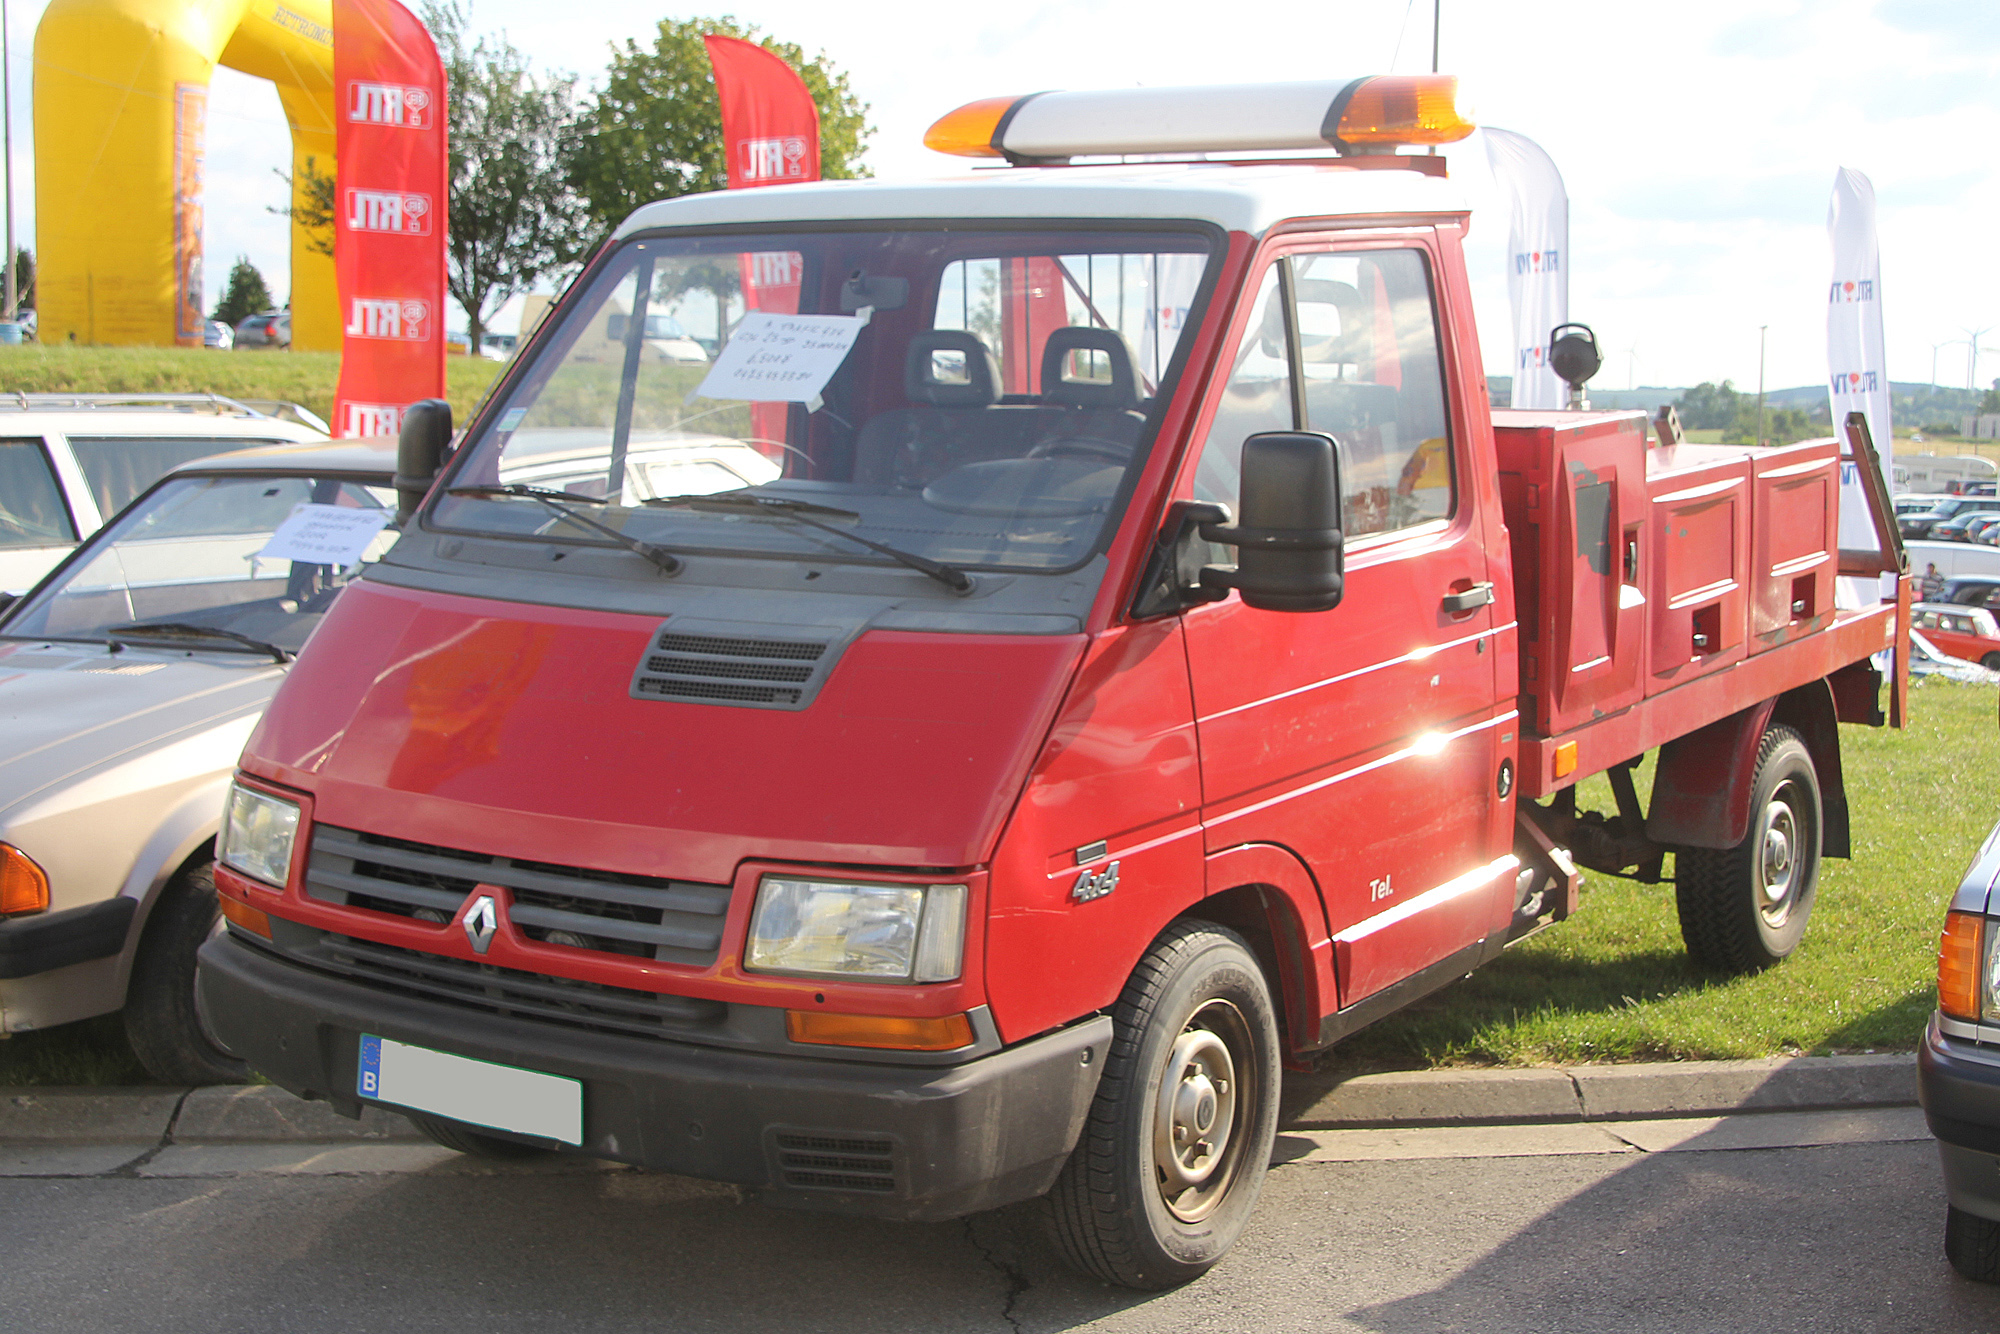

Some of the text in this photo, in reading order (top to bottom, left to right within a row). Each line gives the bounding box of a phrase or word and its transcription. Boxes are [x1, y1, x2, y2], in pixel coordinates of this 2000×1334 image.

[1072, 860, 1120, 903] 4x4
[1369, 874, 1394, 902] Tel.
[363, 1071, 377, 1092] B
